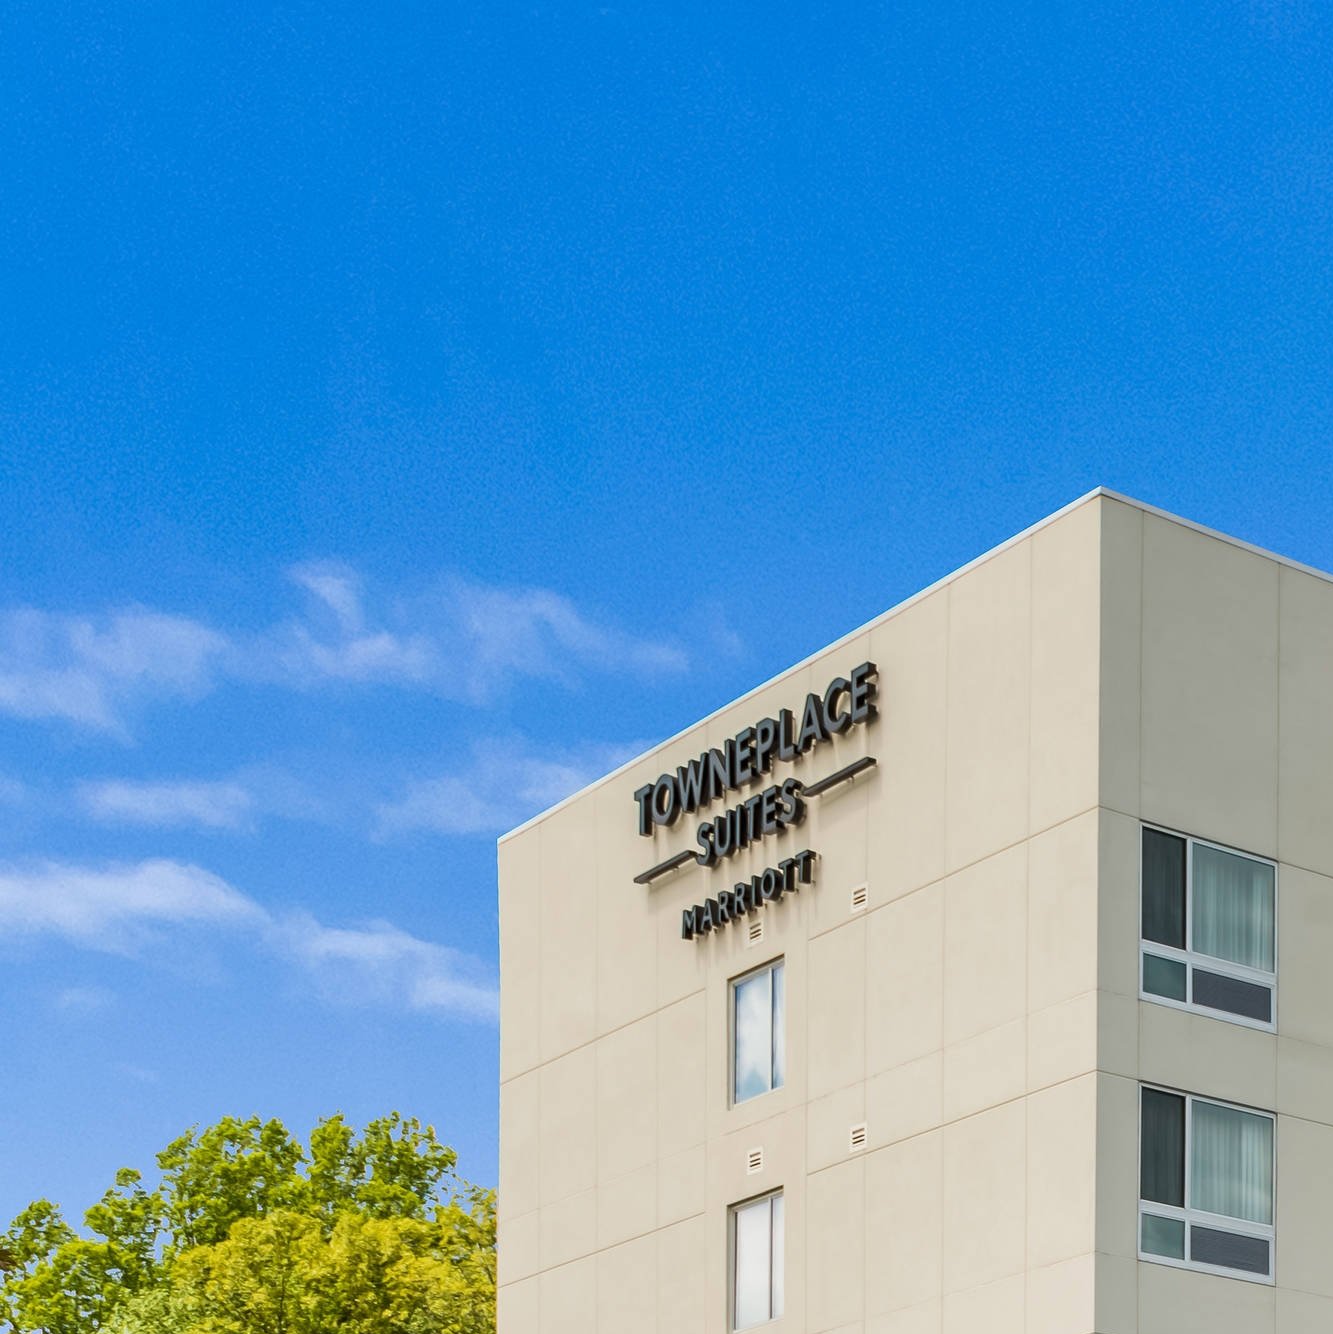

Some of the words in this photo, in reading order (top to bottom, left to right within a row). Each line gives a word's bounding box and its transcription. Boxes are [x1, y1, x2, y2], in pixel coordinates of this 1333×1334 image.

[634, 661, 879, 837] TOWNEPLACE
[696, 777, 806, 867] SUITES
[682, 849, 820, 940] MARRIOTT
